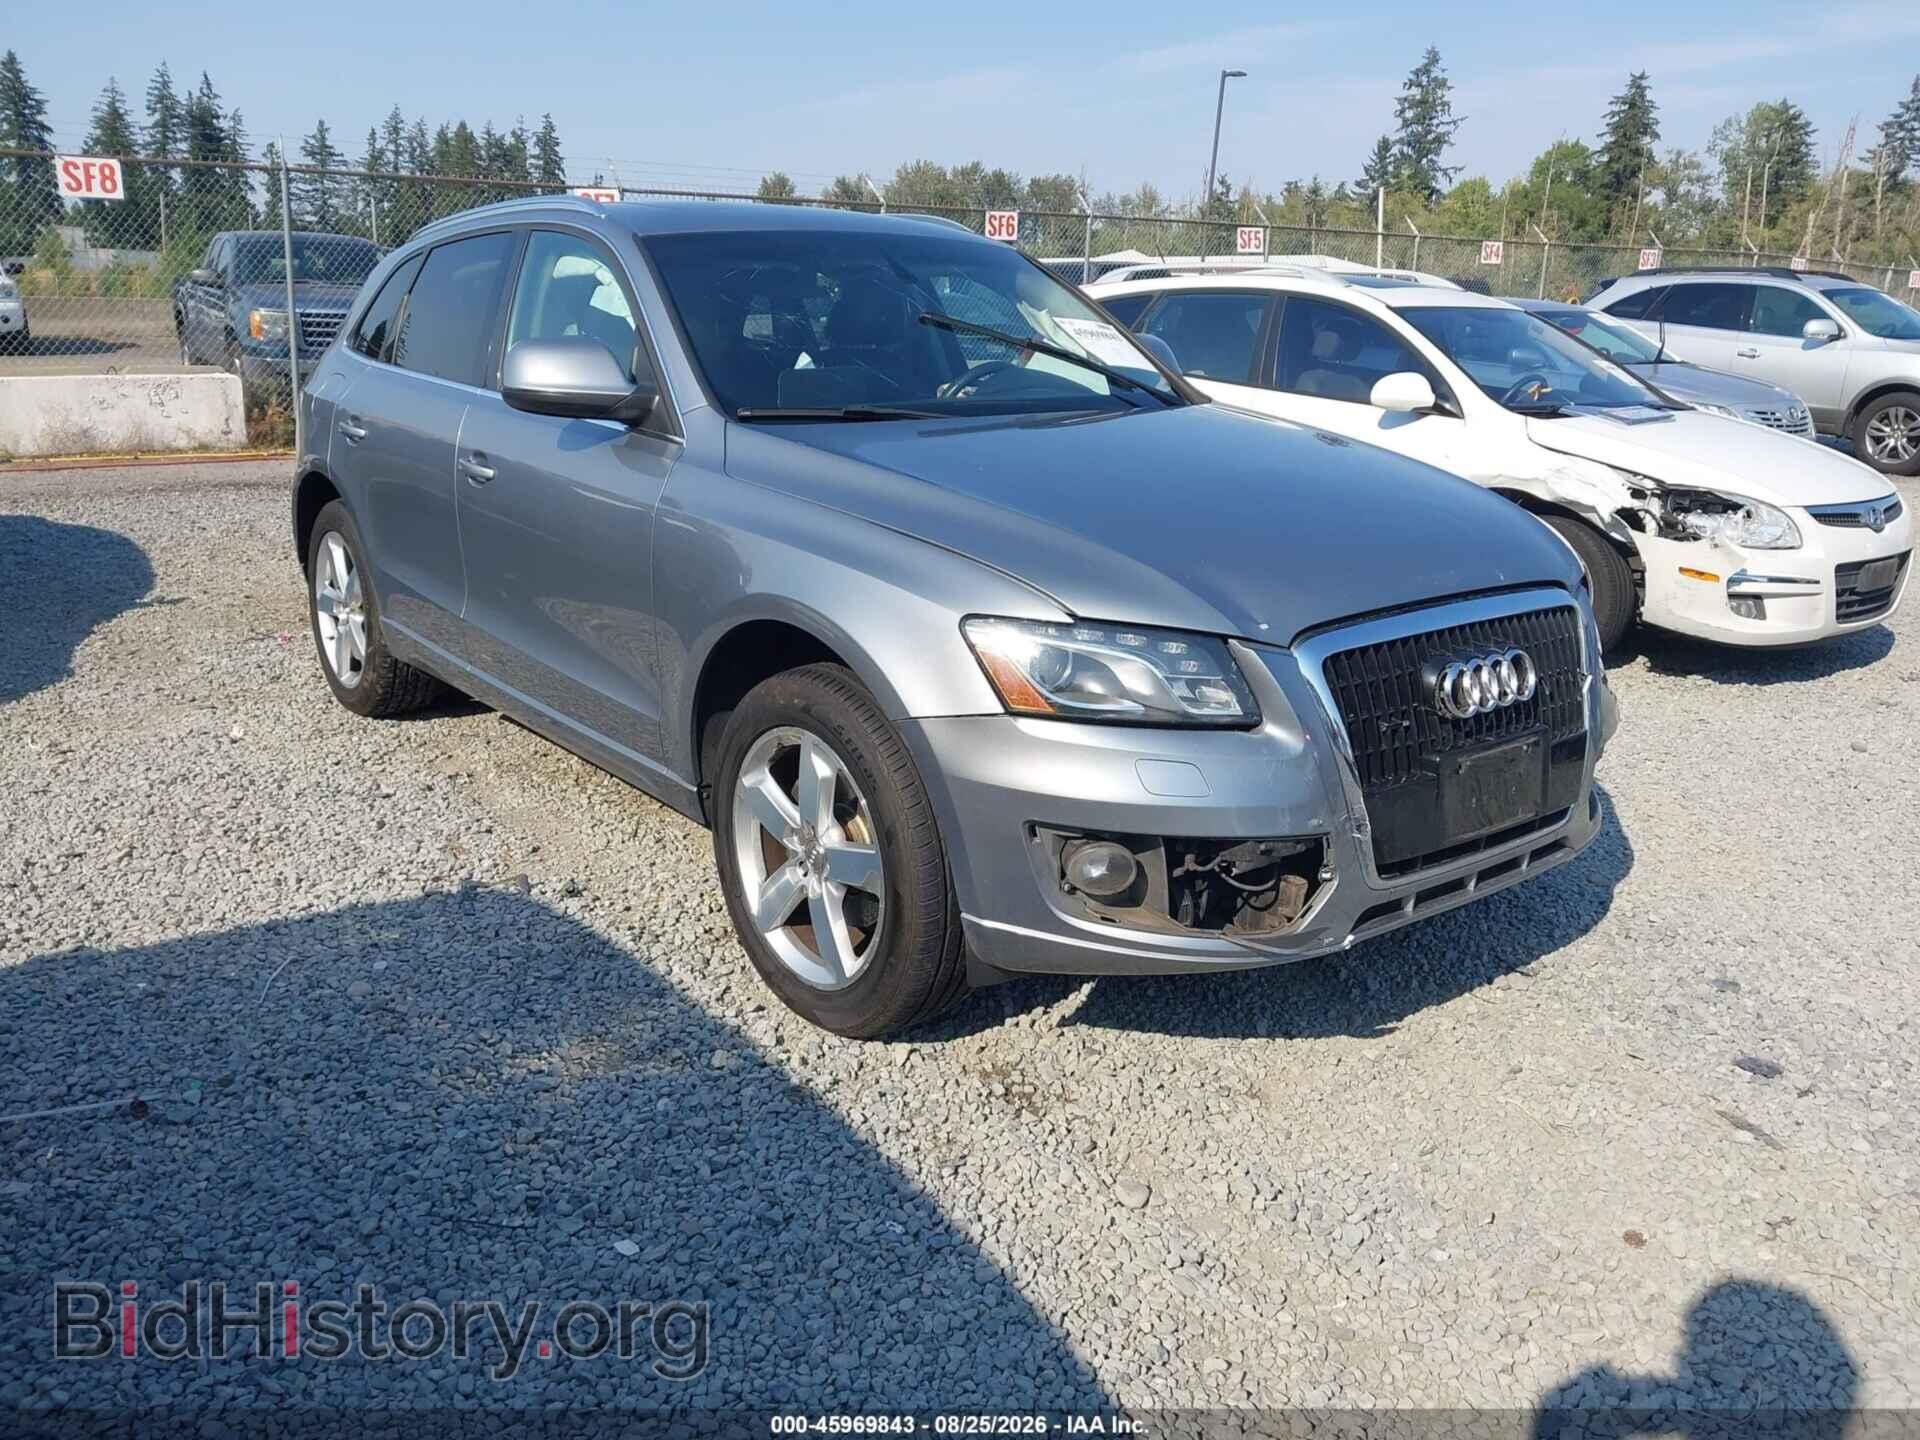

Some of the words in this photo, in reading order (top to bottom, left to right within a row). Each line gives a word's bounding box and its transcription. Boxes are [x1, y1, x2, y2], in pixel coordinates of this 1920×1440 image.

[62, 160, 118, 194] SF8
[988, 214, 1016, 237] SF6
[1240, 230, 1262, 250] SF5
[1483, 243, 1501, 262] SF4
[1641, 251, 1657, 268] SF3
